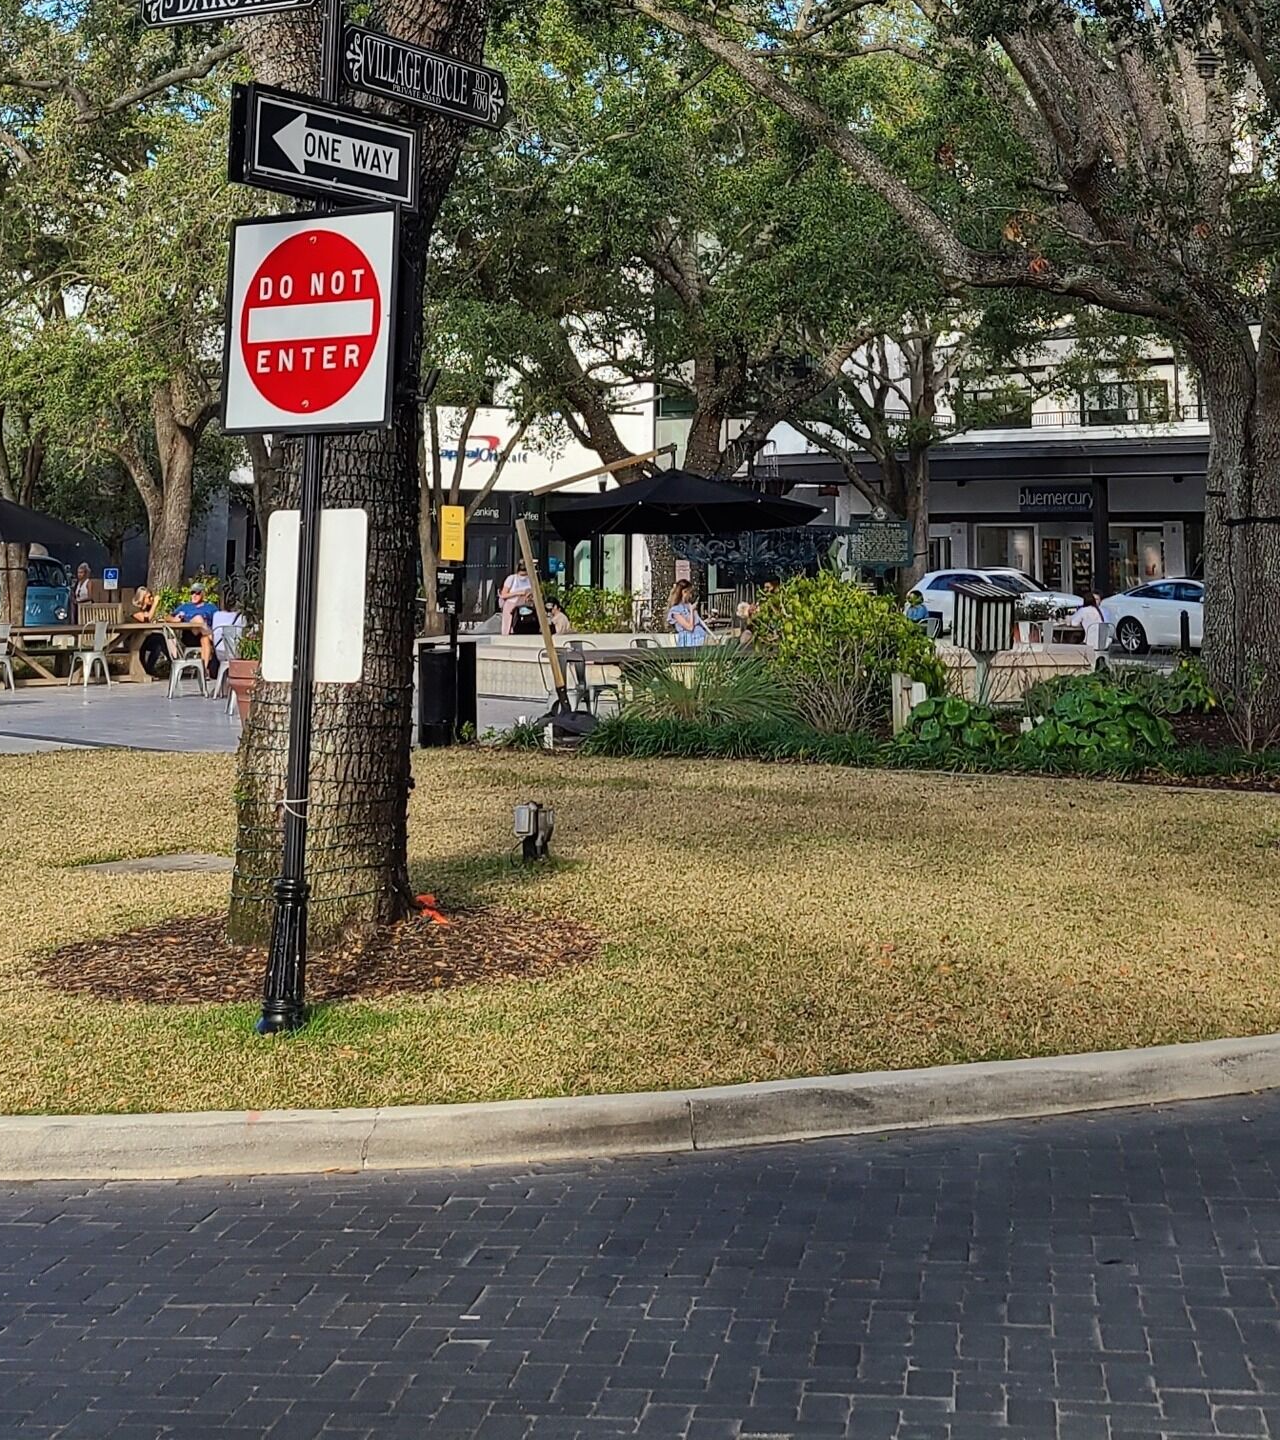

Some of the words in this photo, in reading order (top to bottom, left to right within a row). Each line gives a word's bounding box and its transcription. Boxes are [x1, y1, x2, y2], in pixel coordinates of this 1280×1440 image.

[366, 39, 422, 91] VILLAGE
[423, 57, 469, 105] CIRCLE
[475, 72, 487, 91] RD
[392, 83, 421, 99] PRIVATE
[422, 91, 442, 105] ROAD
[472, 91, 488, 112] 700
[304, 132, 342, 164] ONE
[351, 142, 394, 175] WAY
[259, 274, 293, 301] DO
[310, 268, 365, 297] NOT
[256, 343, 361, 374] ENTER
[1018, 487, 1094, 510] bluemercury
[473, 506, 500, 519] anking
